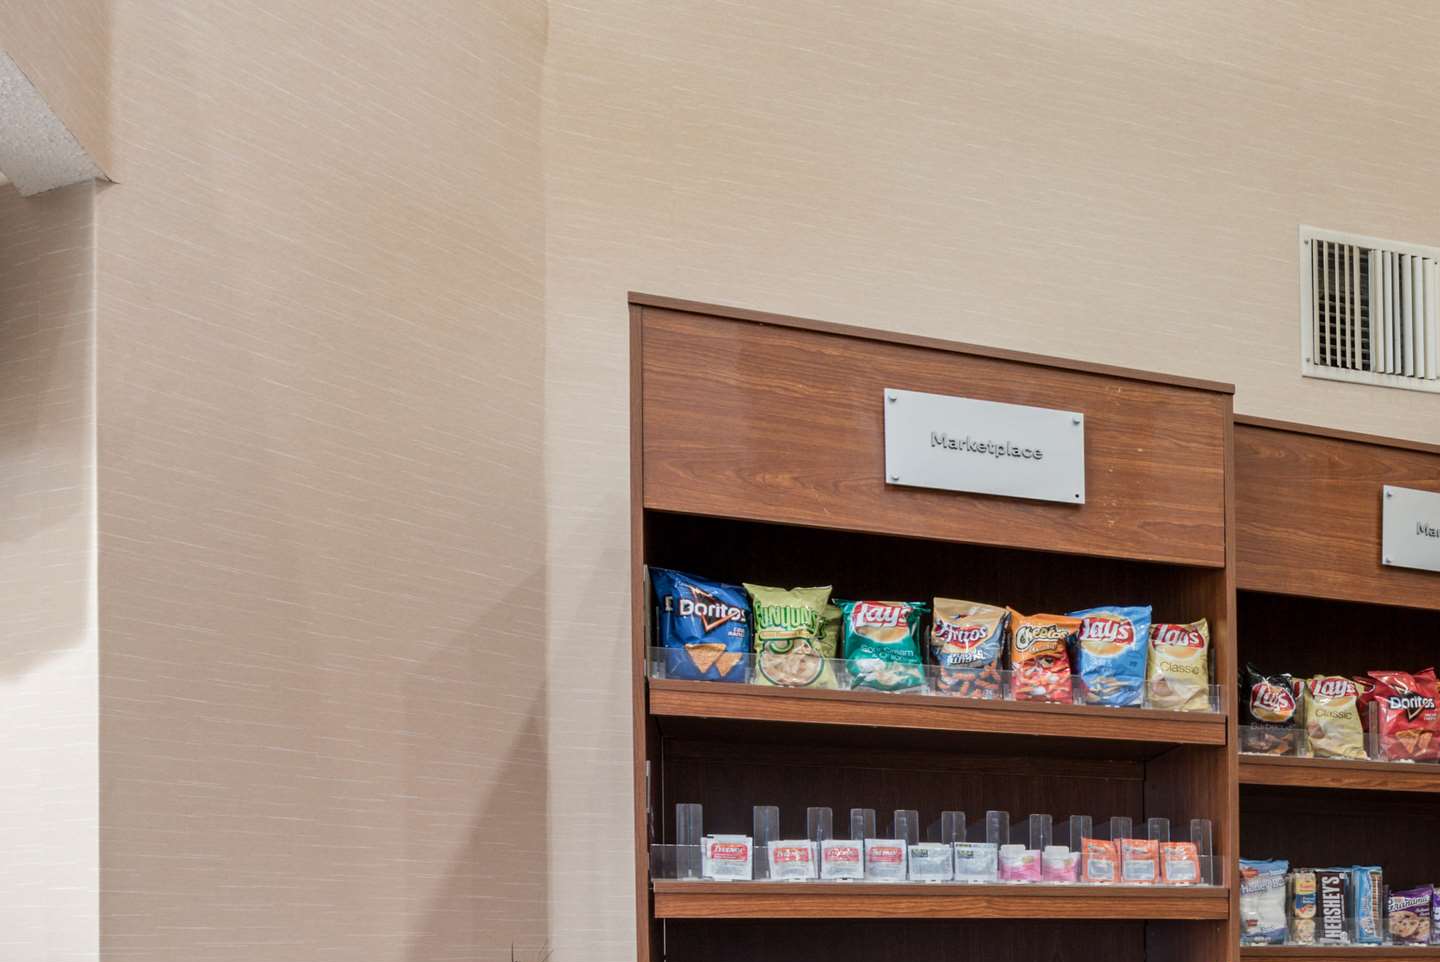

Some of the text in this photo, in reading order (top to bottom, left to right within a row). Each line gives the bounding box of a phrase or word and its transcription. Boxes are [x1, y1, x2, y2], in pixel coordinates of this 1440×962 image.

[930, 431, 1044, 460] Marketplace
[679, 598, 746, 622] Doritos
[855, 602, 912, 628] Lay's
[1015, 624, 1069, 650] Cheetos
[1080, 618, 1130, 642] Lay's
[1152, 624, 1200, 646] Lay's
[1159, 660, 1200, 675] Classic
[1390, 696, 1435, 710] Doritos
[1322, 876, 1343, 938] HERSHEY'S
